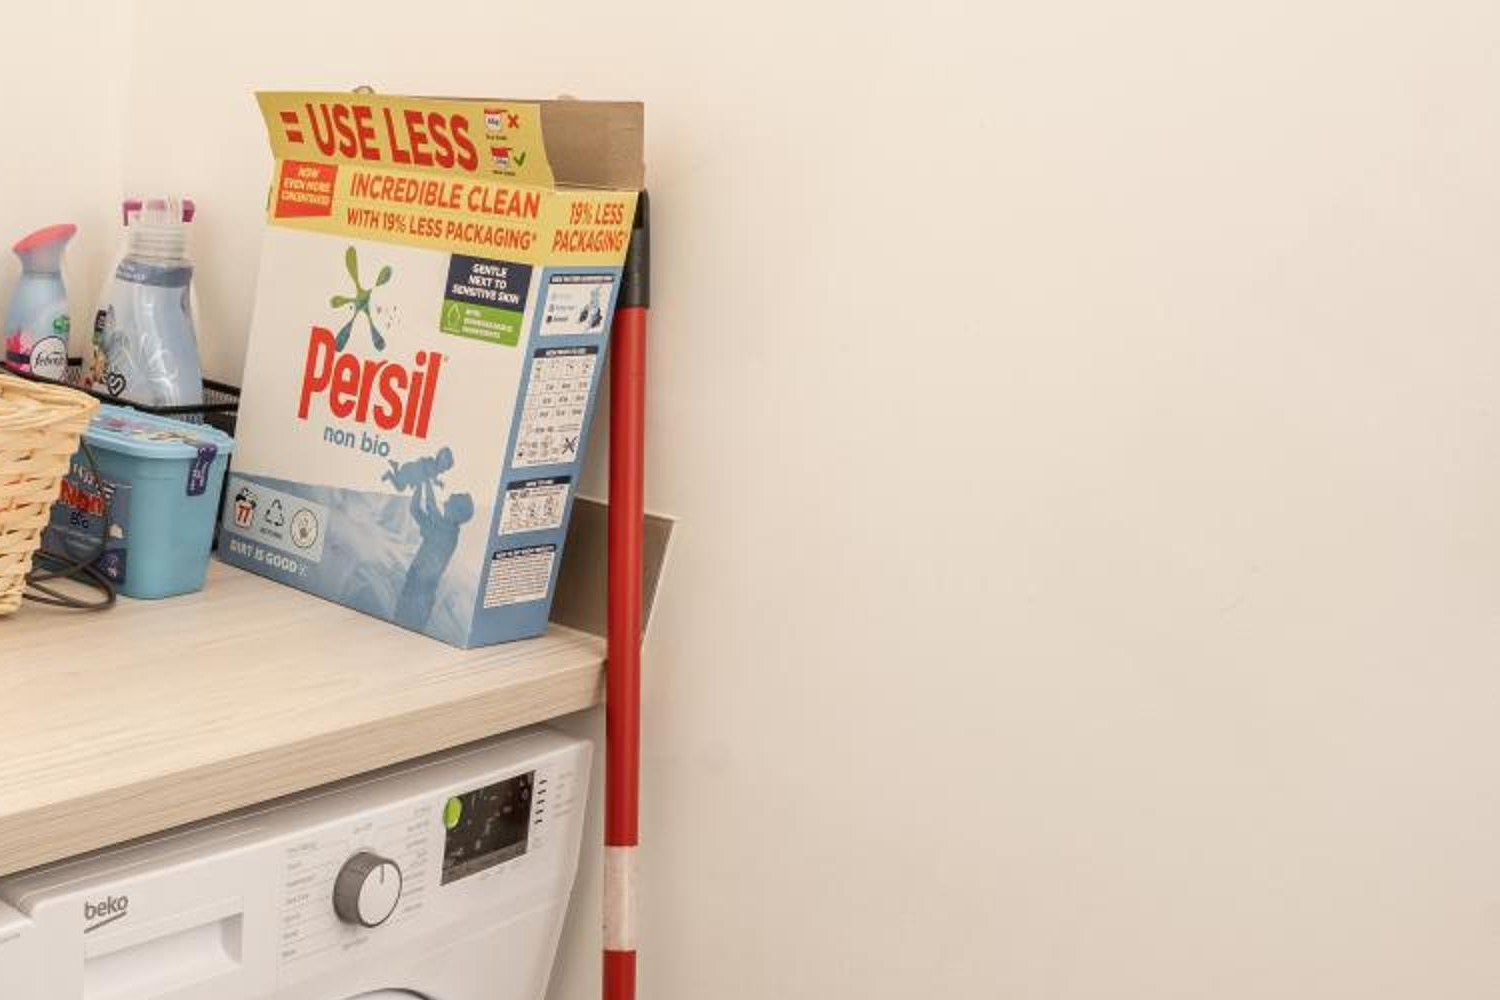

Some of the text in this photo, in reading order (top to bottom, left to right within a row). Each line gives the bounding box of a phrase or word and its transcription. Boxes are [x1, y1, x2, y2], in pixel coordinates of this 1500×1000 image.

[305, 104, 380, 160] USE
[382, 108, 478, 172] LESS
[350, 173, 541, 219] INCREDIBLE CLEAN
[347, 207, 380, 228] WITH
[382, 213, 406, 233] 19%
[409, 217, 443, 238] LESS
[570, 203, 624, 225] 19% LESS
[468, 275, 508, 291] NEXT TO
[472, 263, 508, 279] GENTLE
[451, 284, 497, 302] SENSITIVE
[297, 326, 442, 439] Persil
[323, 426, 390, 457] non bio
[265, 552, 298, 572] GOOD
[84, 895, 129, 920] beko
